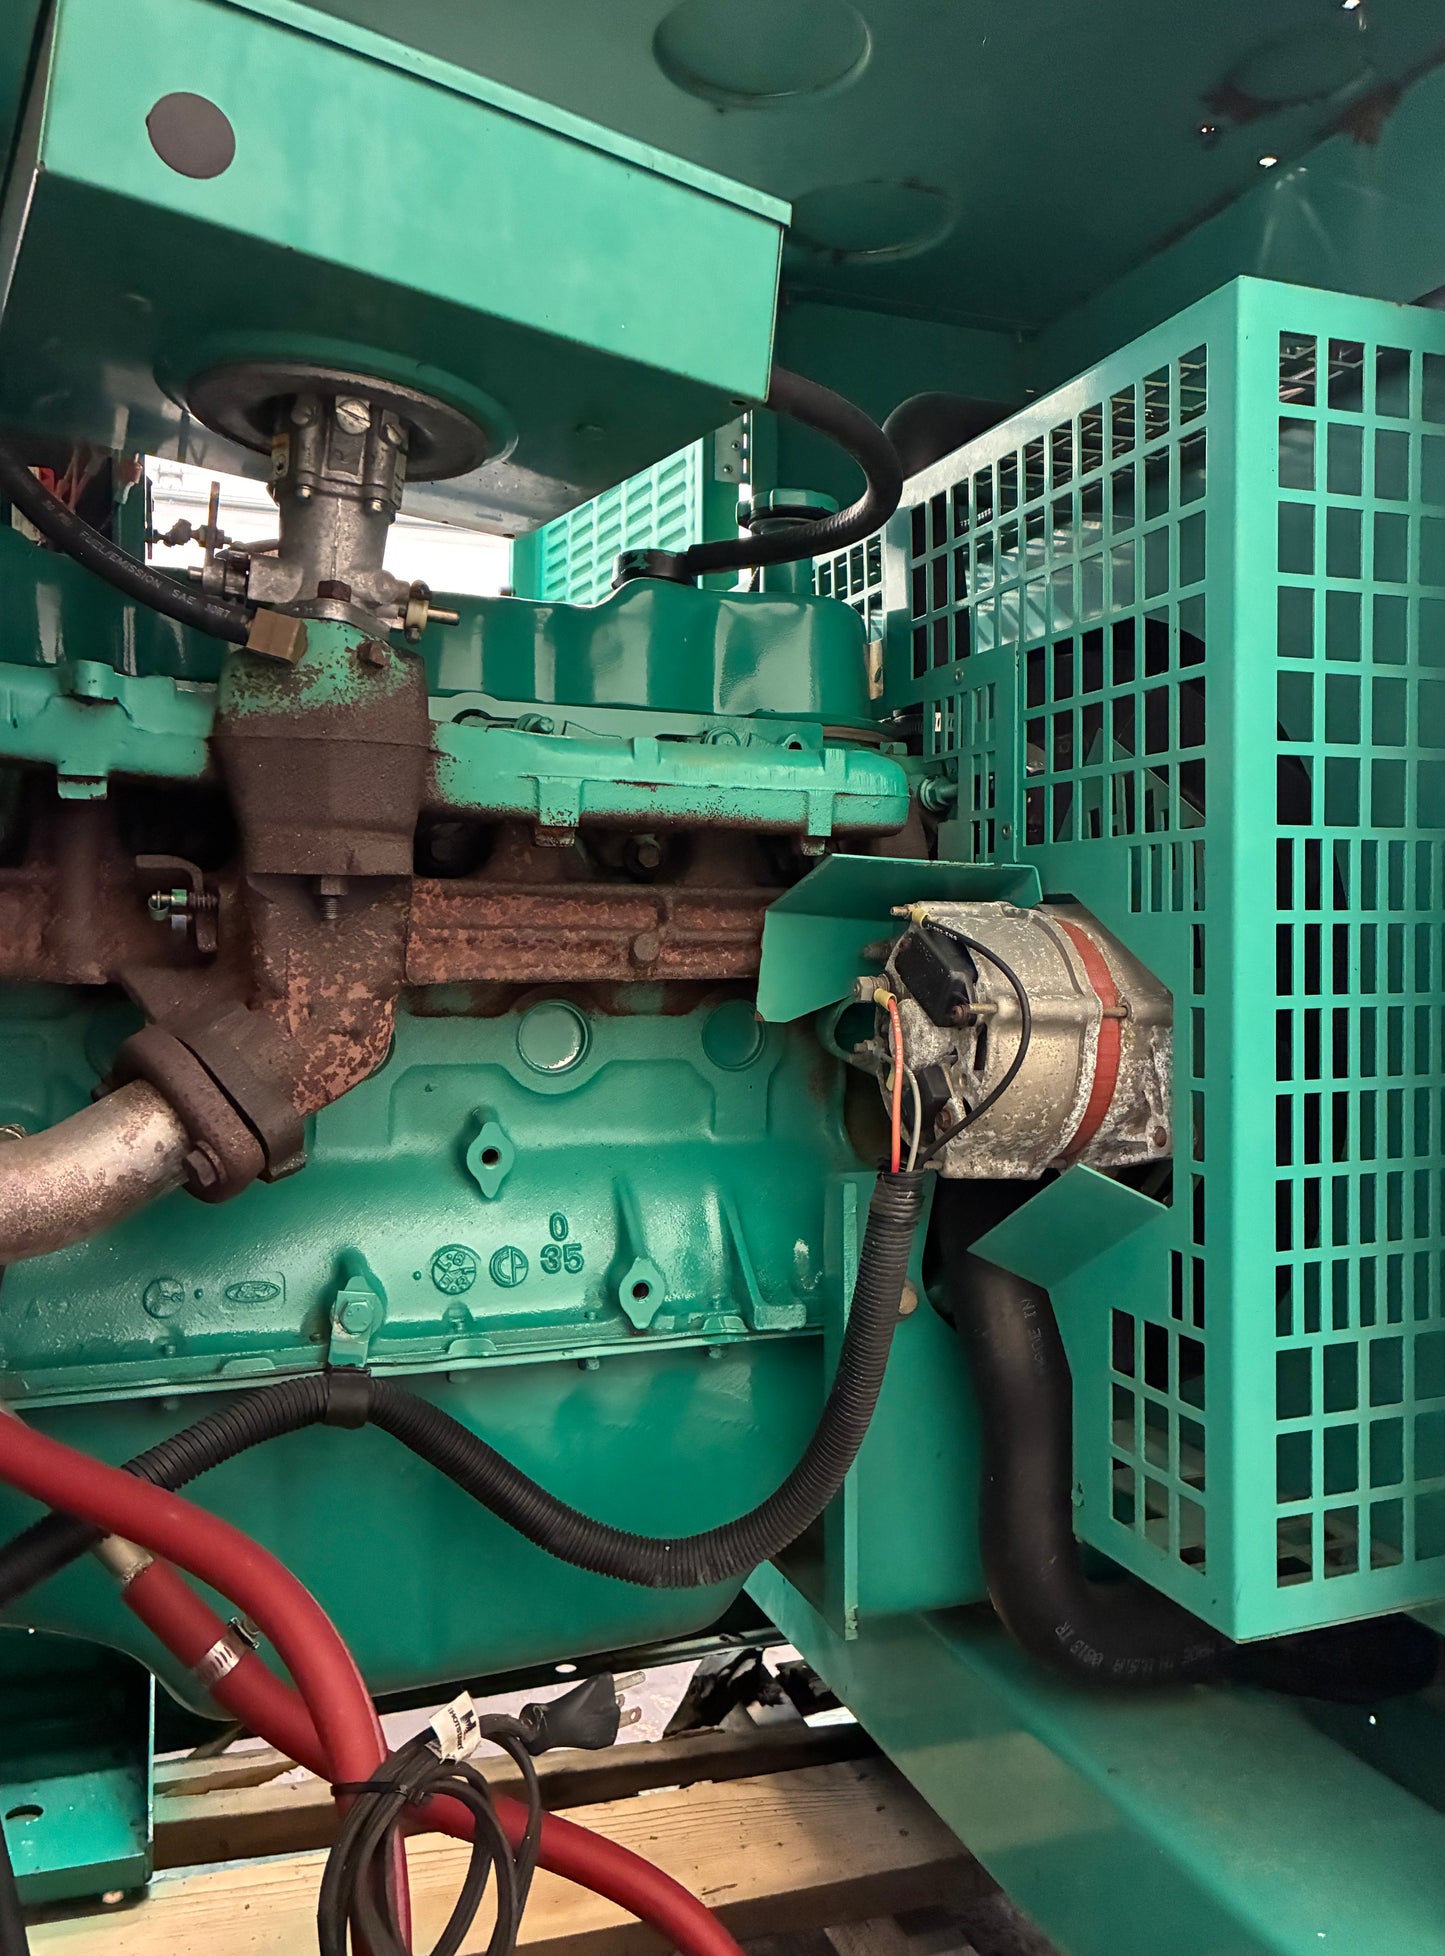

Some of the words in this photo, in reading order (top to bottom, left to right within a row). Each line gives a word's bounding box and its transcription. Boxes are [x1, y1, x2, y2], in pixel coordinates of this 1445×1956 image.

[80, 530, 164, 590] FUEL/EMISSION
[171, 588, 197, 606] SAE
[540, 1243, 585, 1275] 35
